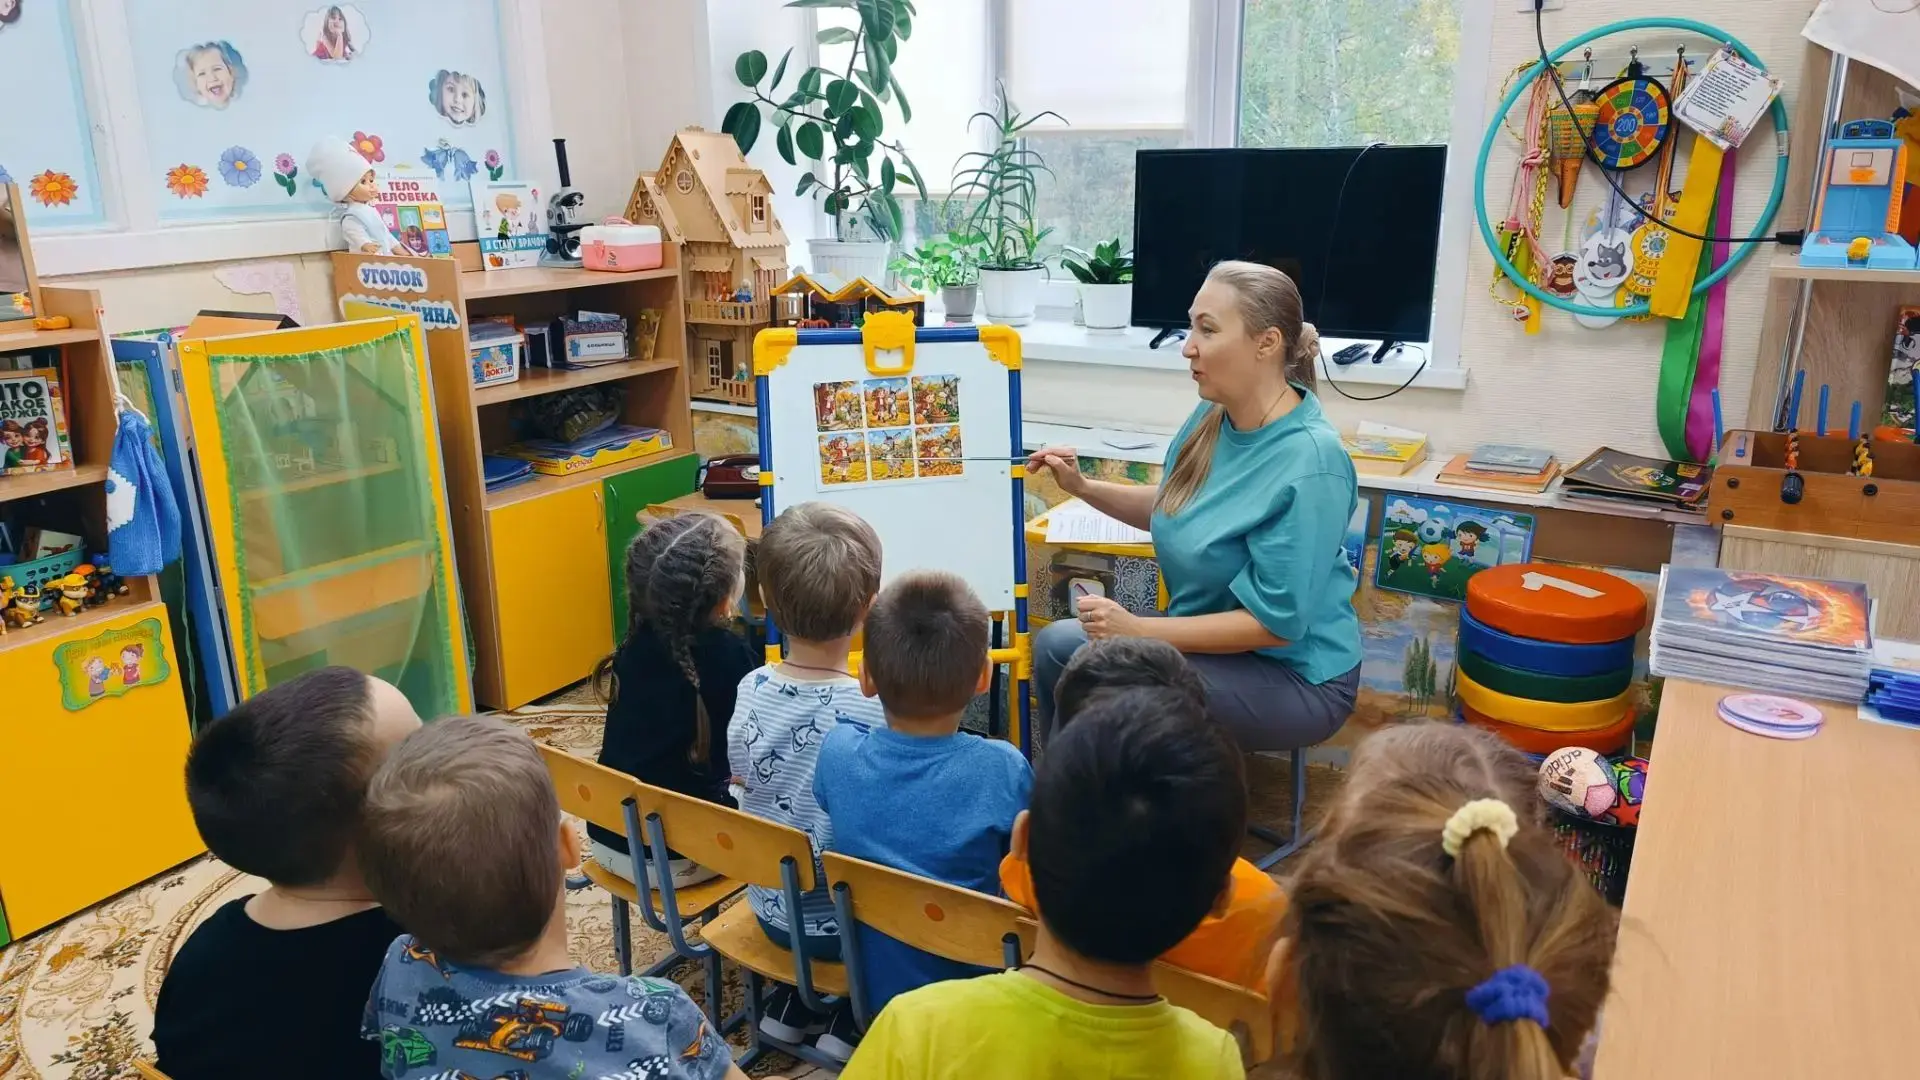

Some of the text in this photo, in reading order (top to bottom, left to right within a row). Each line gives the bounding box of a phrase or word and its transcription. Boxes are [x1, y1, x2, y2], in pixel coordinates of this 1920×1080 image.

[1616, 118, 1636, 132] 200
[388, 181, 420, 192] ТЕЛО
[485, 236, 547, 250] Я СТАНУ ВРАЧОМ
[361, 267, 424, 288] УГОЛОК
[0, 398, 46, 411] АКОЕ
[1, 408, 47, 419] РУЖБА
[1520, 571, 1607, 599] 1
